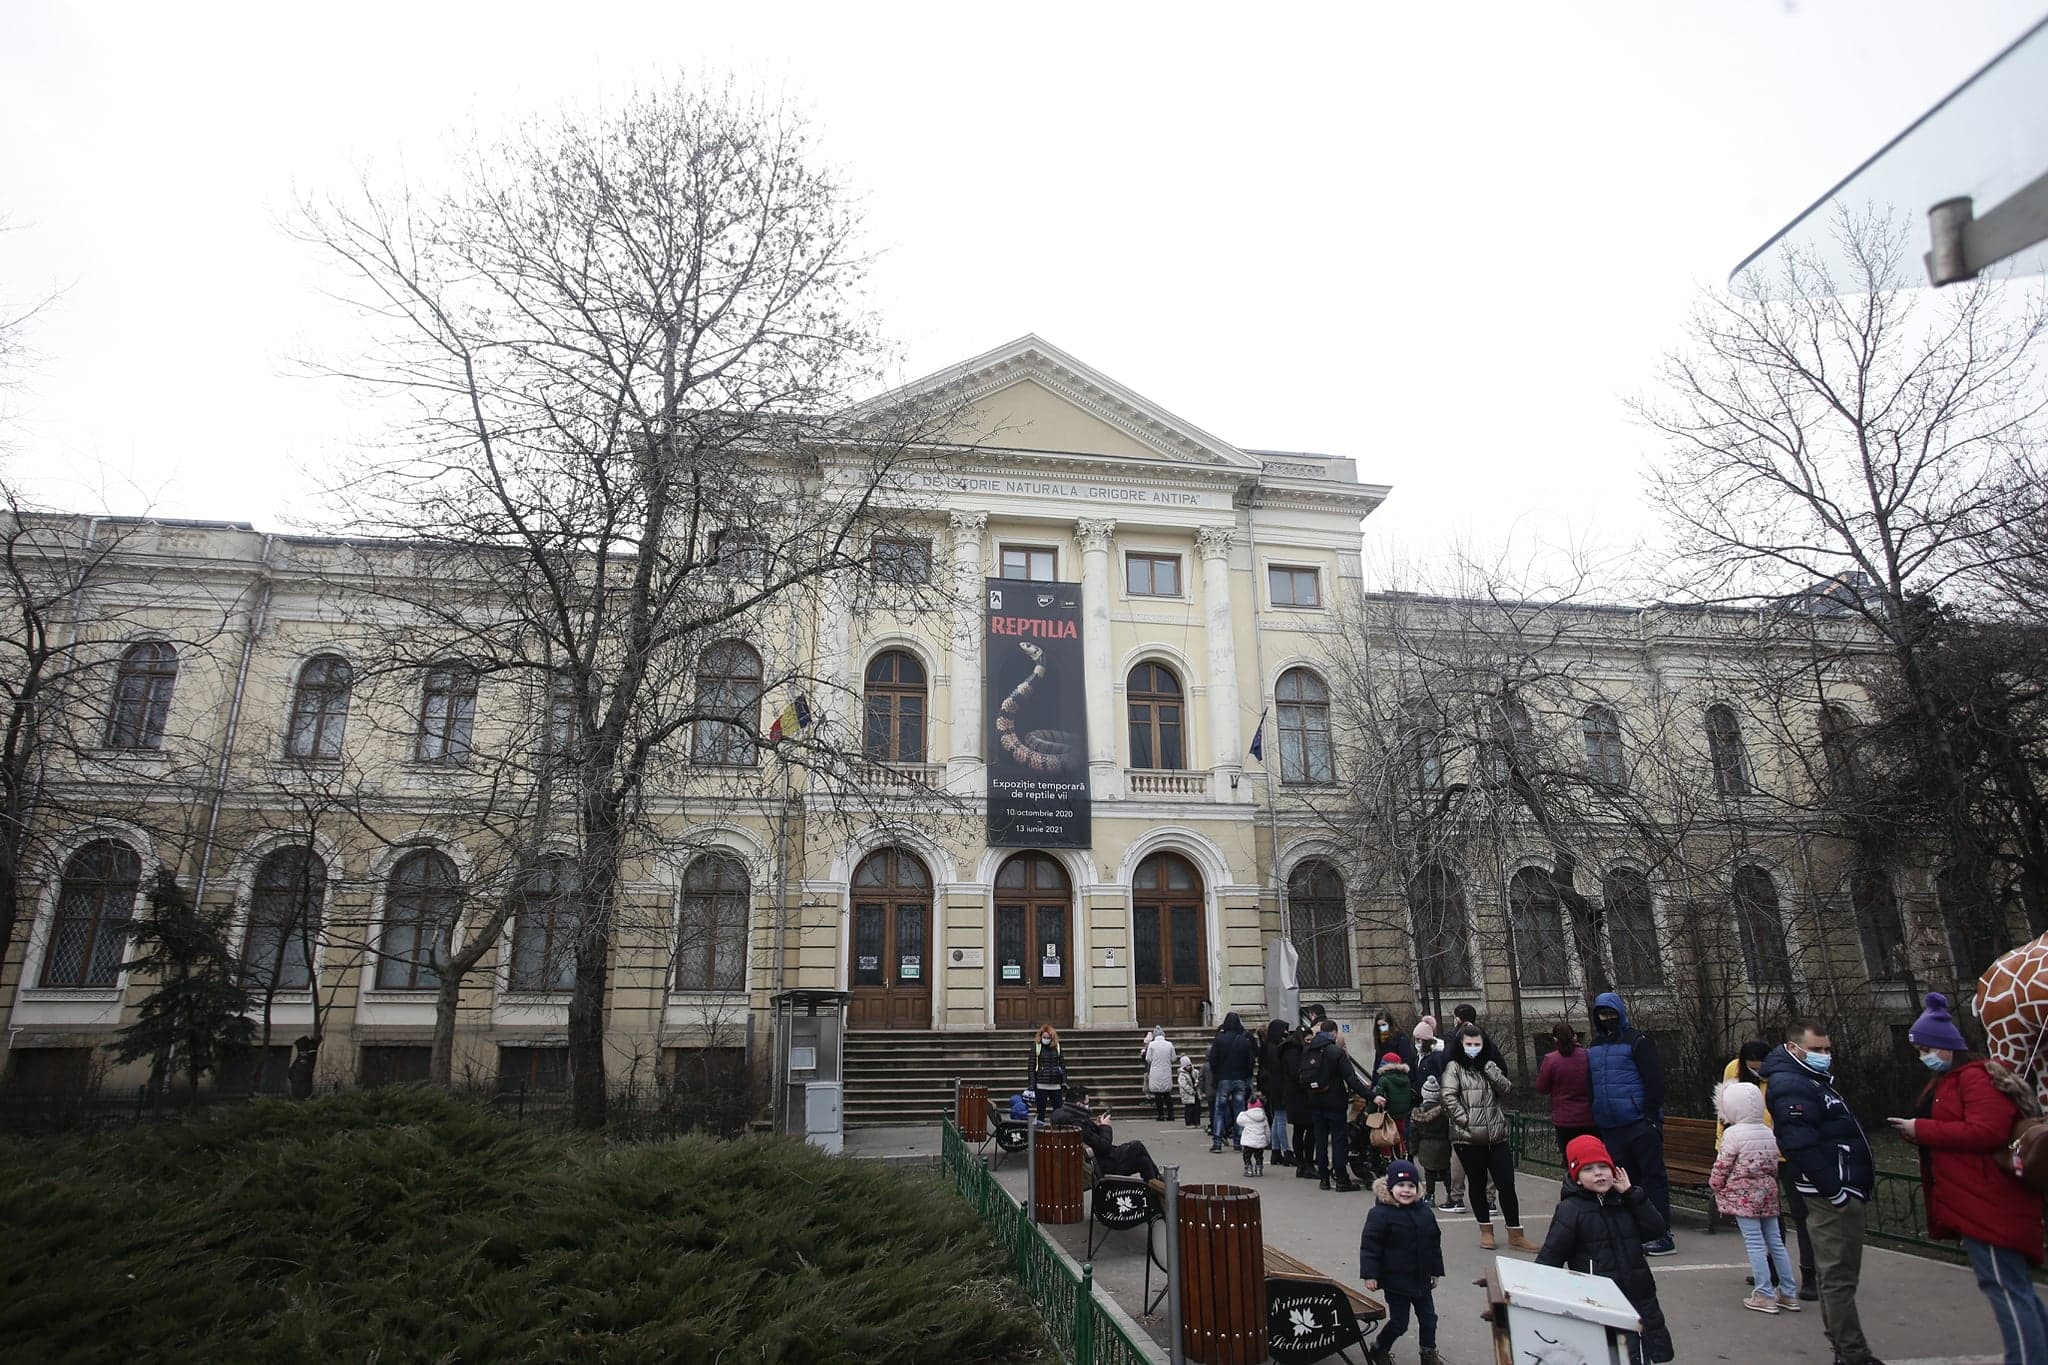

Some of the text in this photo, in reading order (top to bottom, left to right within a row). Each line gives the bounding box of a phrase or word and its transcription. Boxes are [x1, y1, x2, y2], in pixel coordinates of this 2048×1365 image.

[858, 472, 917, 487] MUL
[923, 476, 941, 487] DE
[947, 477, 1001, 491] ISTORIE
[991, 616, 1078, 639] REPTILIA
[1038, 781, 1086, 792] temporară
[1011, 789, 1069, 800] de reptile vii
[1016, 809, 1054, 817] octombrie
[1055, 810, 1074, 818] 2020
[1026, 825, 1044, 833] iunie
[1142, 1196, 1149, 1208] 1
[1271, 1294, 1333, 1316] Primaria
[1331, 1309, 1341, 1327] 1
[1268, 1331, 1336, 1350] Sectorului
